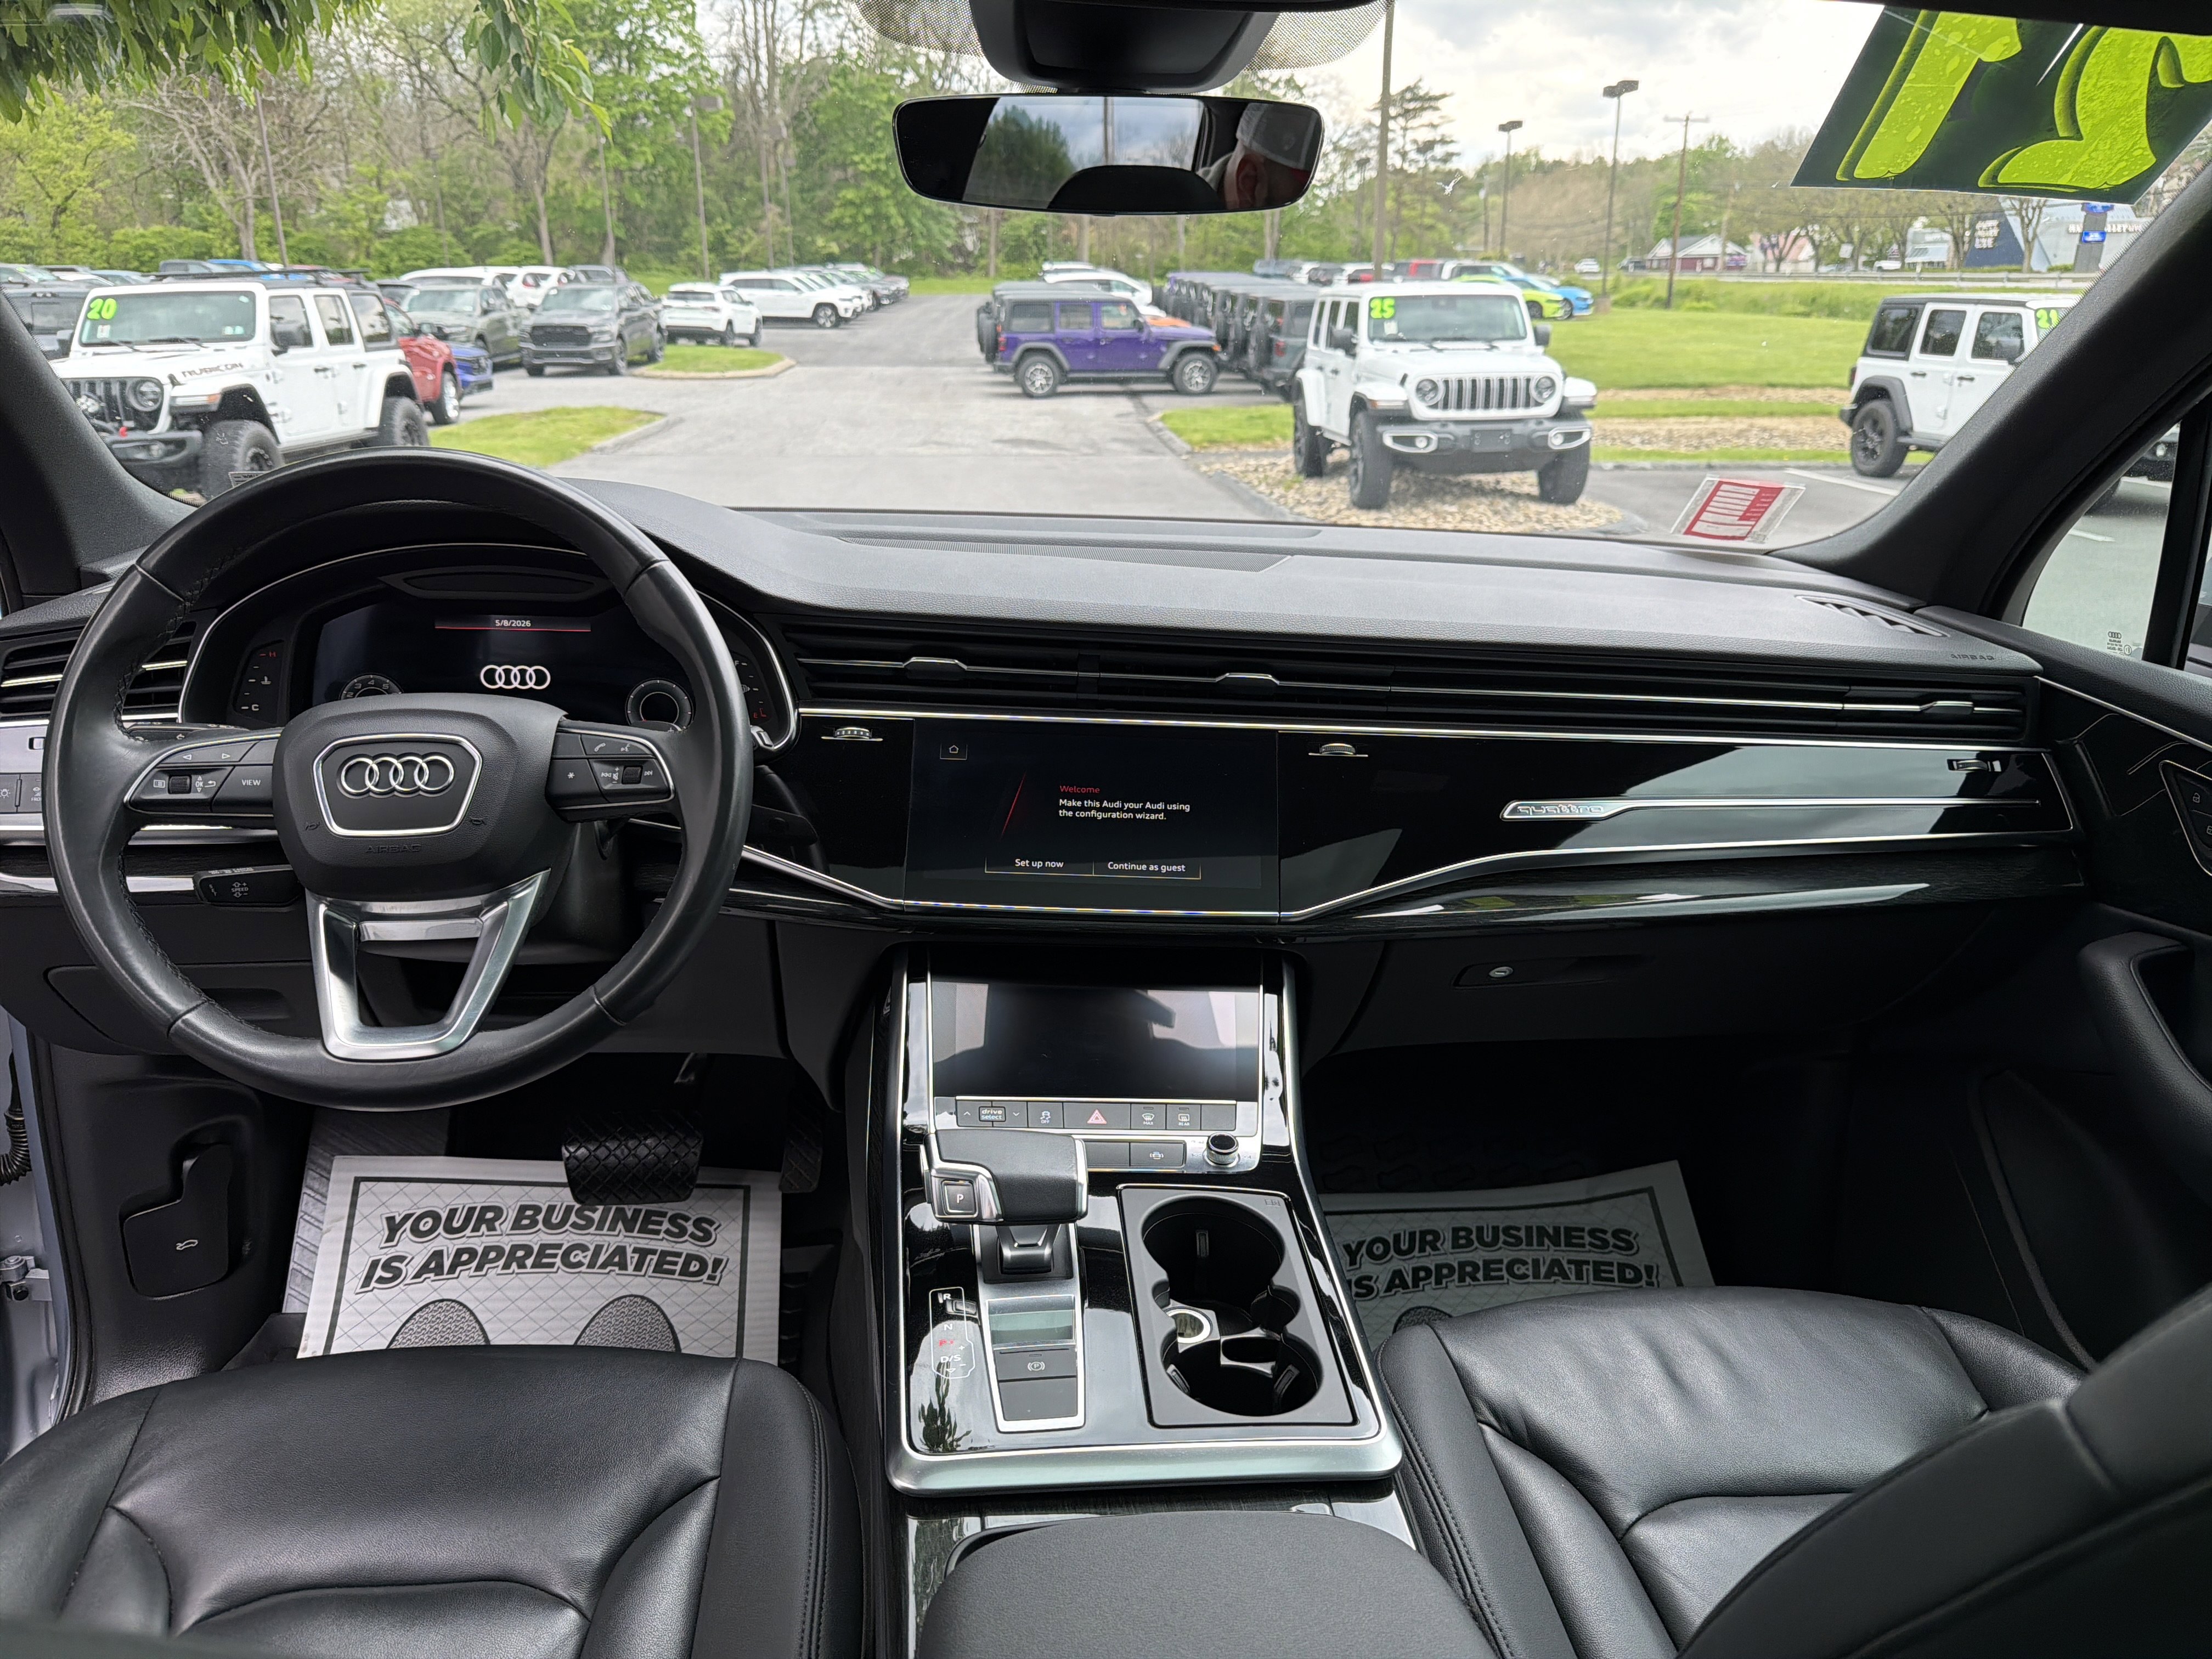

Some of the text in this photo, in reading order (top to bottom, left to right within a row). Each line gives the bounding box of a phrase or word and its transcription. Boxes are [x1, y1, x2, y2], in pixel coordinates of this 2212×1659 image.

[87, 297, 117, 320] 20
[1370, 298, 1395, 319] 25
[1059, 785, 1100, 794] Welcome
[1059, 799, 1082, 807] Make
[1084, 799, 1101, 808] this
[1102, 800, 1122, 809] Audi
[1145, 802, 1165, 810] Audi
[1167, 803, 1190, 812] using
[1517, 804, 1604, 816] quattro
[1059, 809, 1167, 820] the configuration wizard.
[364, 844, 422, 854] AIRBAG
[1014, 859, 1030, 867] Set
[1108, 861, 1147, 871] Continue
[1160, 864, 1186, 873] guest
[208, 884, 217, 896] SET
[956, 1194, 964, 1204] P
[382, 1203, 721, 1248] YOUR BUSINESS
[1342, 1224, 1639, 1268] YOUR BUSINESS
[356, 1241, 729, 1294] IS APPRECIATED!
[1380, 1257, 1660, 1297] APPRECIATED!
[944, 1323, 953, 1331] N
[940, 1354, 961, 1363] D/S
